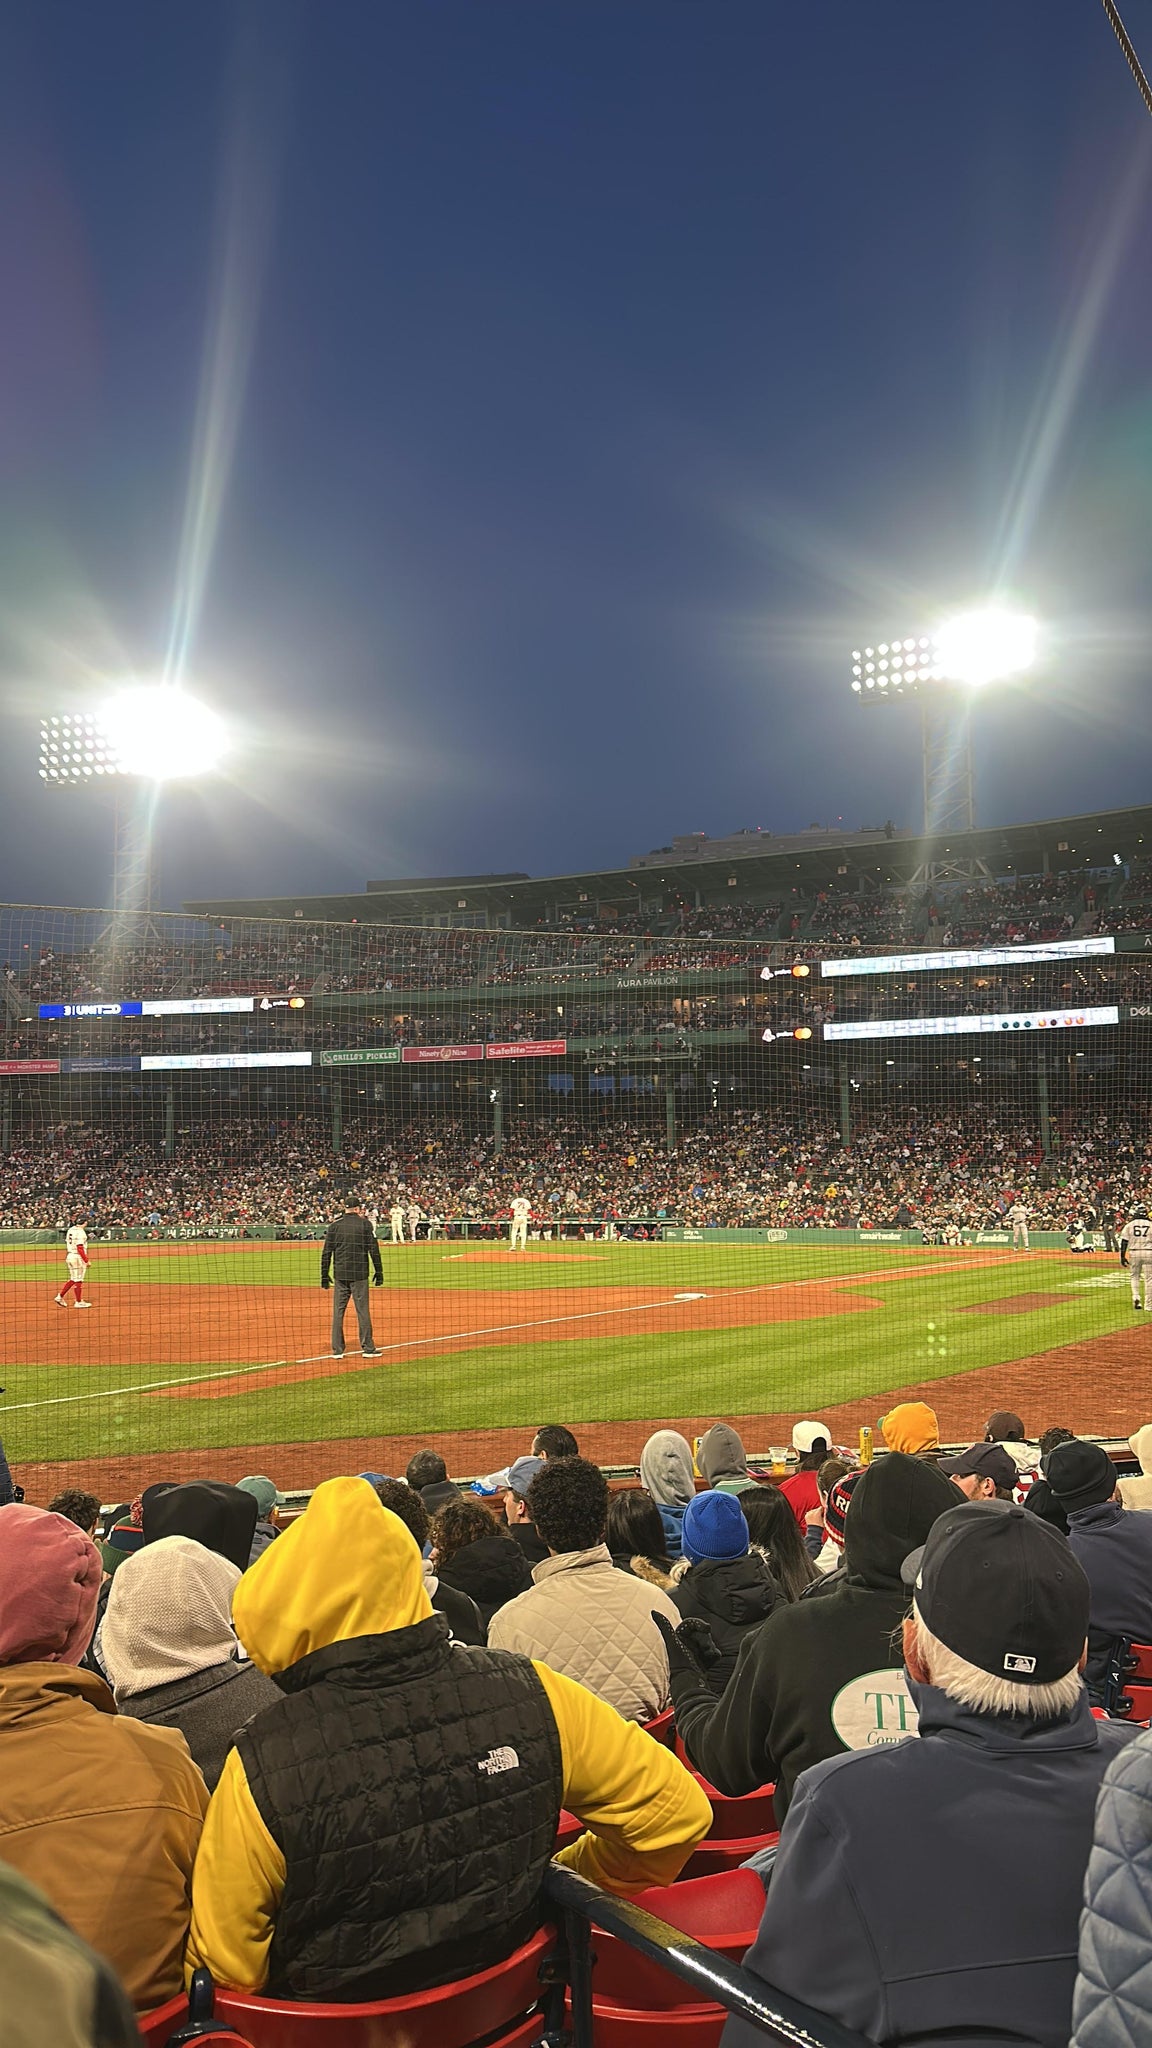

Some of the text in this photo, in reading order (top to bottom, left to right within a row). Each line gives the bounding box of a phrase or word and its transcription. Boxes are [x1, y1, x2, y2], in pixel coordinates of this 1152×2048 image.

[643, 976, 679, 986] PAVILION
[332, 1051, 397, 1061] GRILLO'S PICKLES
[419, 1050, 440, 1058] Ninety
[488, 1046, 526, 1056] Safelite
[1133, 1225, 1150, 1237] 67
[859, 1232, 902, 1241] smartwater
[976, 1232, 1010, 1243] Franklin
[487, 1747, 504, 1758] THE
[477, 1756, 505, 1770] NORTH
[486, 1763, 509, 1776] FACE
